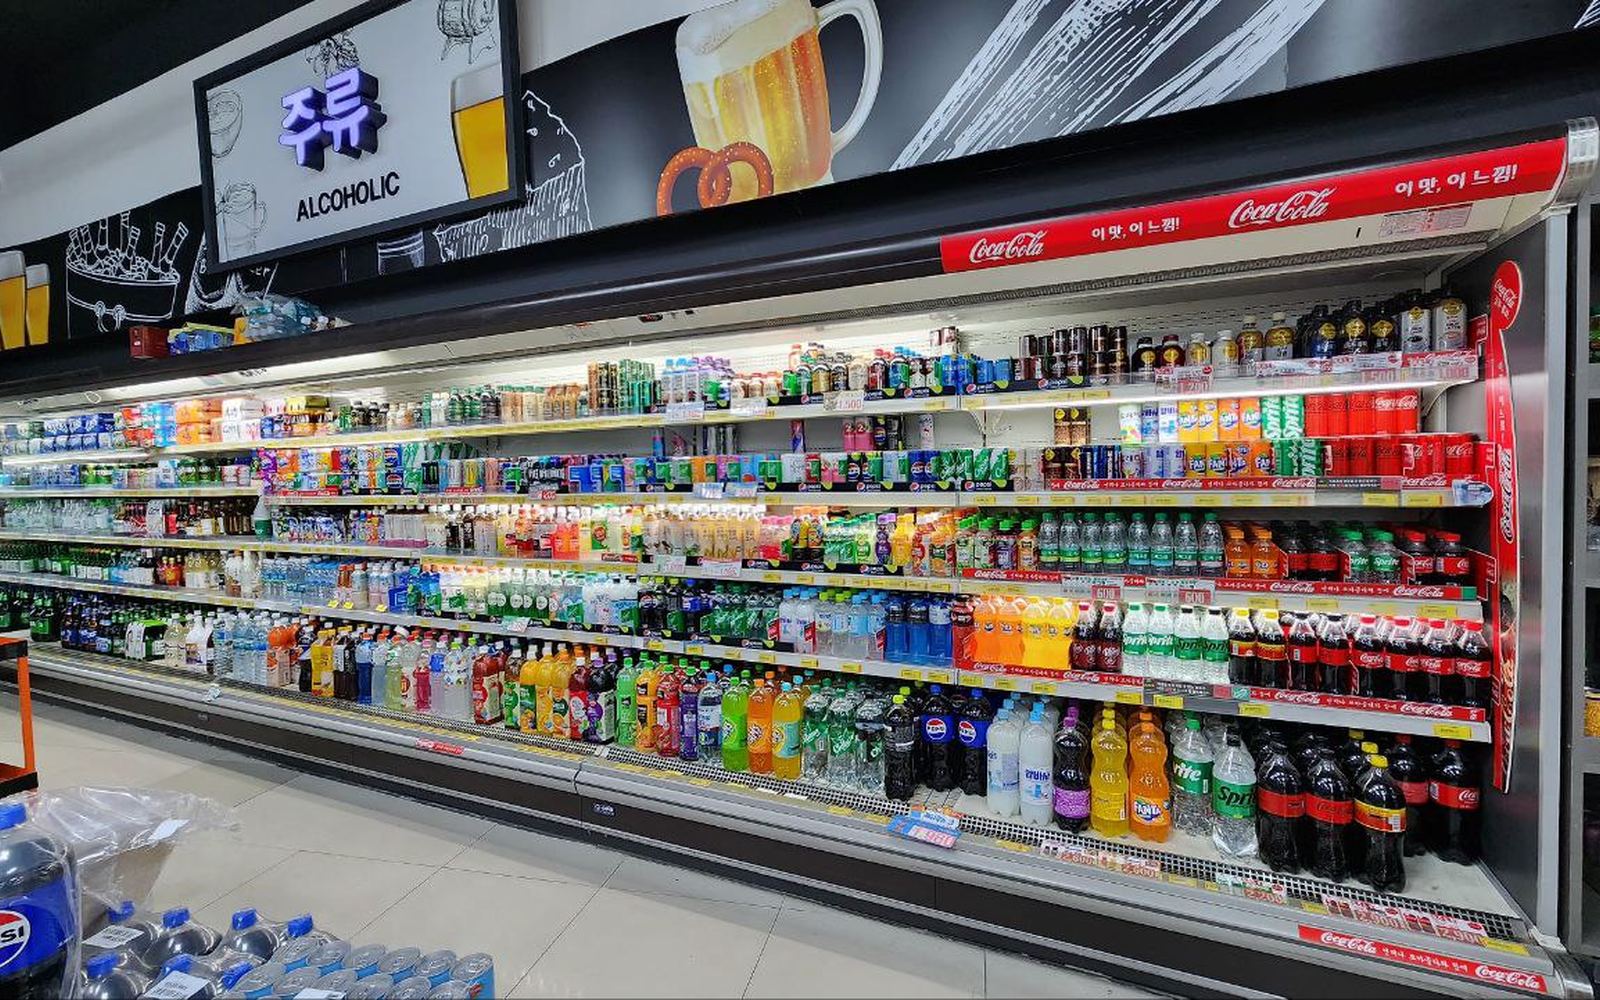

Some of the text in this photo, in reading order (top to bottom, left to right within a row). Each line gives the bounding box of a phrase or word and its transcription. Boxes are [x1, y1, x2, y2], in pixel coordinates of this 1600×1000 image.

[278, 67, 382, 170] 주류
[296, 171, 400, 223] ALCOHOLIC
[1395, 163, 1518, 198] 이 맛, 이 느낌!
[1091, 217, 1180, 241] 이 맛, 이 느낌!
[1320, 931, 1377, 955] Coca-Cola
[1475, 964, 1540, 990] Coca-Cola
